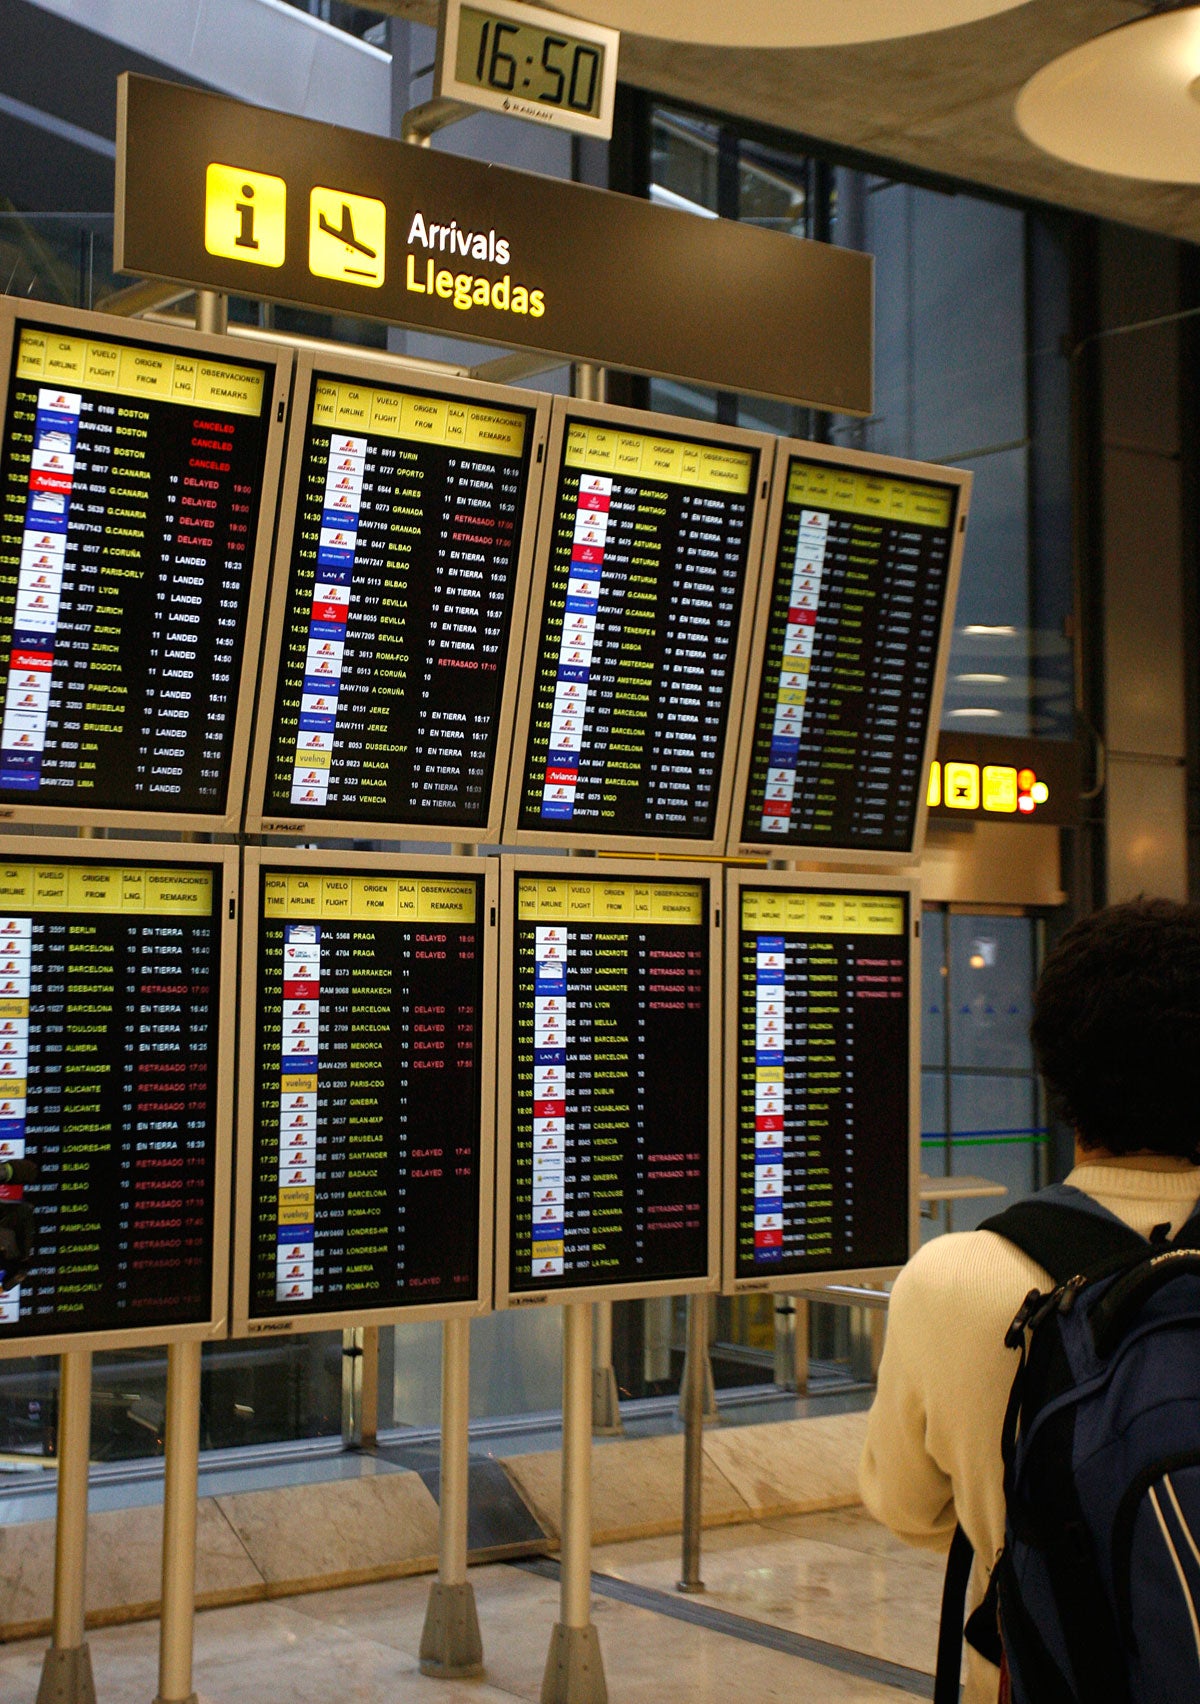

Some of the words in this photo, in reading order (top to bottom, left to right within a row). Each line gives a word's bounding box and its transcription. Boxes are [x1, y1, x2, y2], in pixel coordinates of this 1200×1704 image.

[476, 20, 599, 112] 16:50
[407, 212, 511, 265] Arrivals
[406, 254, 545, 317] Llegadas
[21, 338, 45, 348] HORA
[59, 343, 71, 351] CIA
[91, 349, 116, 359] VUELO
[134, 358, 162, 368] ORIGEN
[176, 364, 194, 373] SALA
[201, 368, 260, 384] OBSERVACIONES
[22, 356, 41, 365] TIME
[48, 360, 77, 370] AIRLINE
[89, 367, 115, 377] FLIGHT
[137, 375, 157, 384] FROM
[210, 388, 247, 399] REMARKS
[316, 388, 336, 397] HORA
[377, 397, 398, 406] VUELO
[413, 405, 438, 414] ORIGEN
[449, 409, 465, 418] SALA
[470, 413, 522, 428] OBSERVACIONES
[117, 408, 149, 420] BOSTON
[193, 419, 235, 433] CANCELED
[316, 404, 334, 413] TIME
[339, 407, 364, 417] AIRLINE
[374, 414, 397, 423] FLIGHT
[415, 420, 432, 429] FROM
[478, 431, 511, 441] REMARKS
[116, 427, 147, 438] BOSTON
[192, 438, 232, 451] CANCELED
[114, 447, 145, 459] BOSTON
[189, 459, 230, 472] CANCELED
[399, 451, 418, 460] TURIN
[461, 461, 470, 469] EN
[472, 462, 495, 473] TIERRA
[568, 446, 583, 454] TIME
[619, 454, 638, 463] FLIGHT
[112, 467, 151, 479] G.CANARIA
[183, 477, 219, 490] DELAYED
[308, 475, 325, 484] 14:30
[403, 488, 421, 498] AIRES
[397, 468, 424, 478] OPORTO
[459, 478, 468, 487] EN
[470, 479, 493, 490] TIERRA
[109, 487, 149, 499] G.CANARIA
[182, 496, 217, 509] DELAYED
[704, 499, 725, 509] TIERRA
[306, 493, 323, 503] 14:30
[392, 506, 423, 516] GRANADA
[455, 514, 495, 526] RETRASADO
[175, 555, 206, 566] LANDED
[101, 566, 144, 579] PARIS-ORLY
[173, 575, 204, 586] LANDED
[352, 575, 364, 584] LAN
[384, 579, 407, 589] BILBAO
[382, 598, 407, 608] SEVILLA
[96, 605, 123, 615] ZURICH
[169, 613, 200, 624] LANDED
[375, 652, 409, 662] ROMA-FCO
[438, 658, 478, 669] RETRASADO
[90, 662, 122, 672] BOGOTA
[163, 668, 194, 679] LANDED
[88, 683, 128, 694] PAMPLONA
[86, 702, 125, 713] BRUSELAS
[283, 699, 300, 708] 14:40
[369, 707, 390, 715] JEREZ
[365, 743, 408, 752] DUSSELDORF
[151, 765, 183, 776] LANDED
[300, 755, 325, 765] vueling
[331, 759, 344, 767] VLG
[363, 761, 389, 770] MALAGA
[551, 771, 577, 781] Avianca
[359, 795, 386, 804] VENECIA
[149, 877, 209, 885] OBSERVACIONES
[38, 889, 64, 897] FLIGHT
[160, 893, 197, 902] REMARKS
[156, 928, 183, 936] TIERRA
[68, 945, 114, 953] BARCELONA
[141, 985, 188, 993] RETRASADO
[264, 1006, 281, 1014] 17:00
[286, 1079, 312, 1088] vueling
[349, 1098, 378, 1106] GINEBRA
[349, 1134, 383, 1142] BRUSELAS
[348, 1170, 377, 1178] BADAJOZ
[411, 1169, 442, 1177] DELAYED
